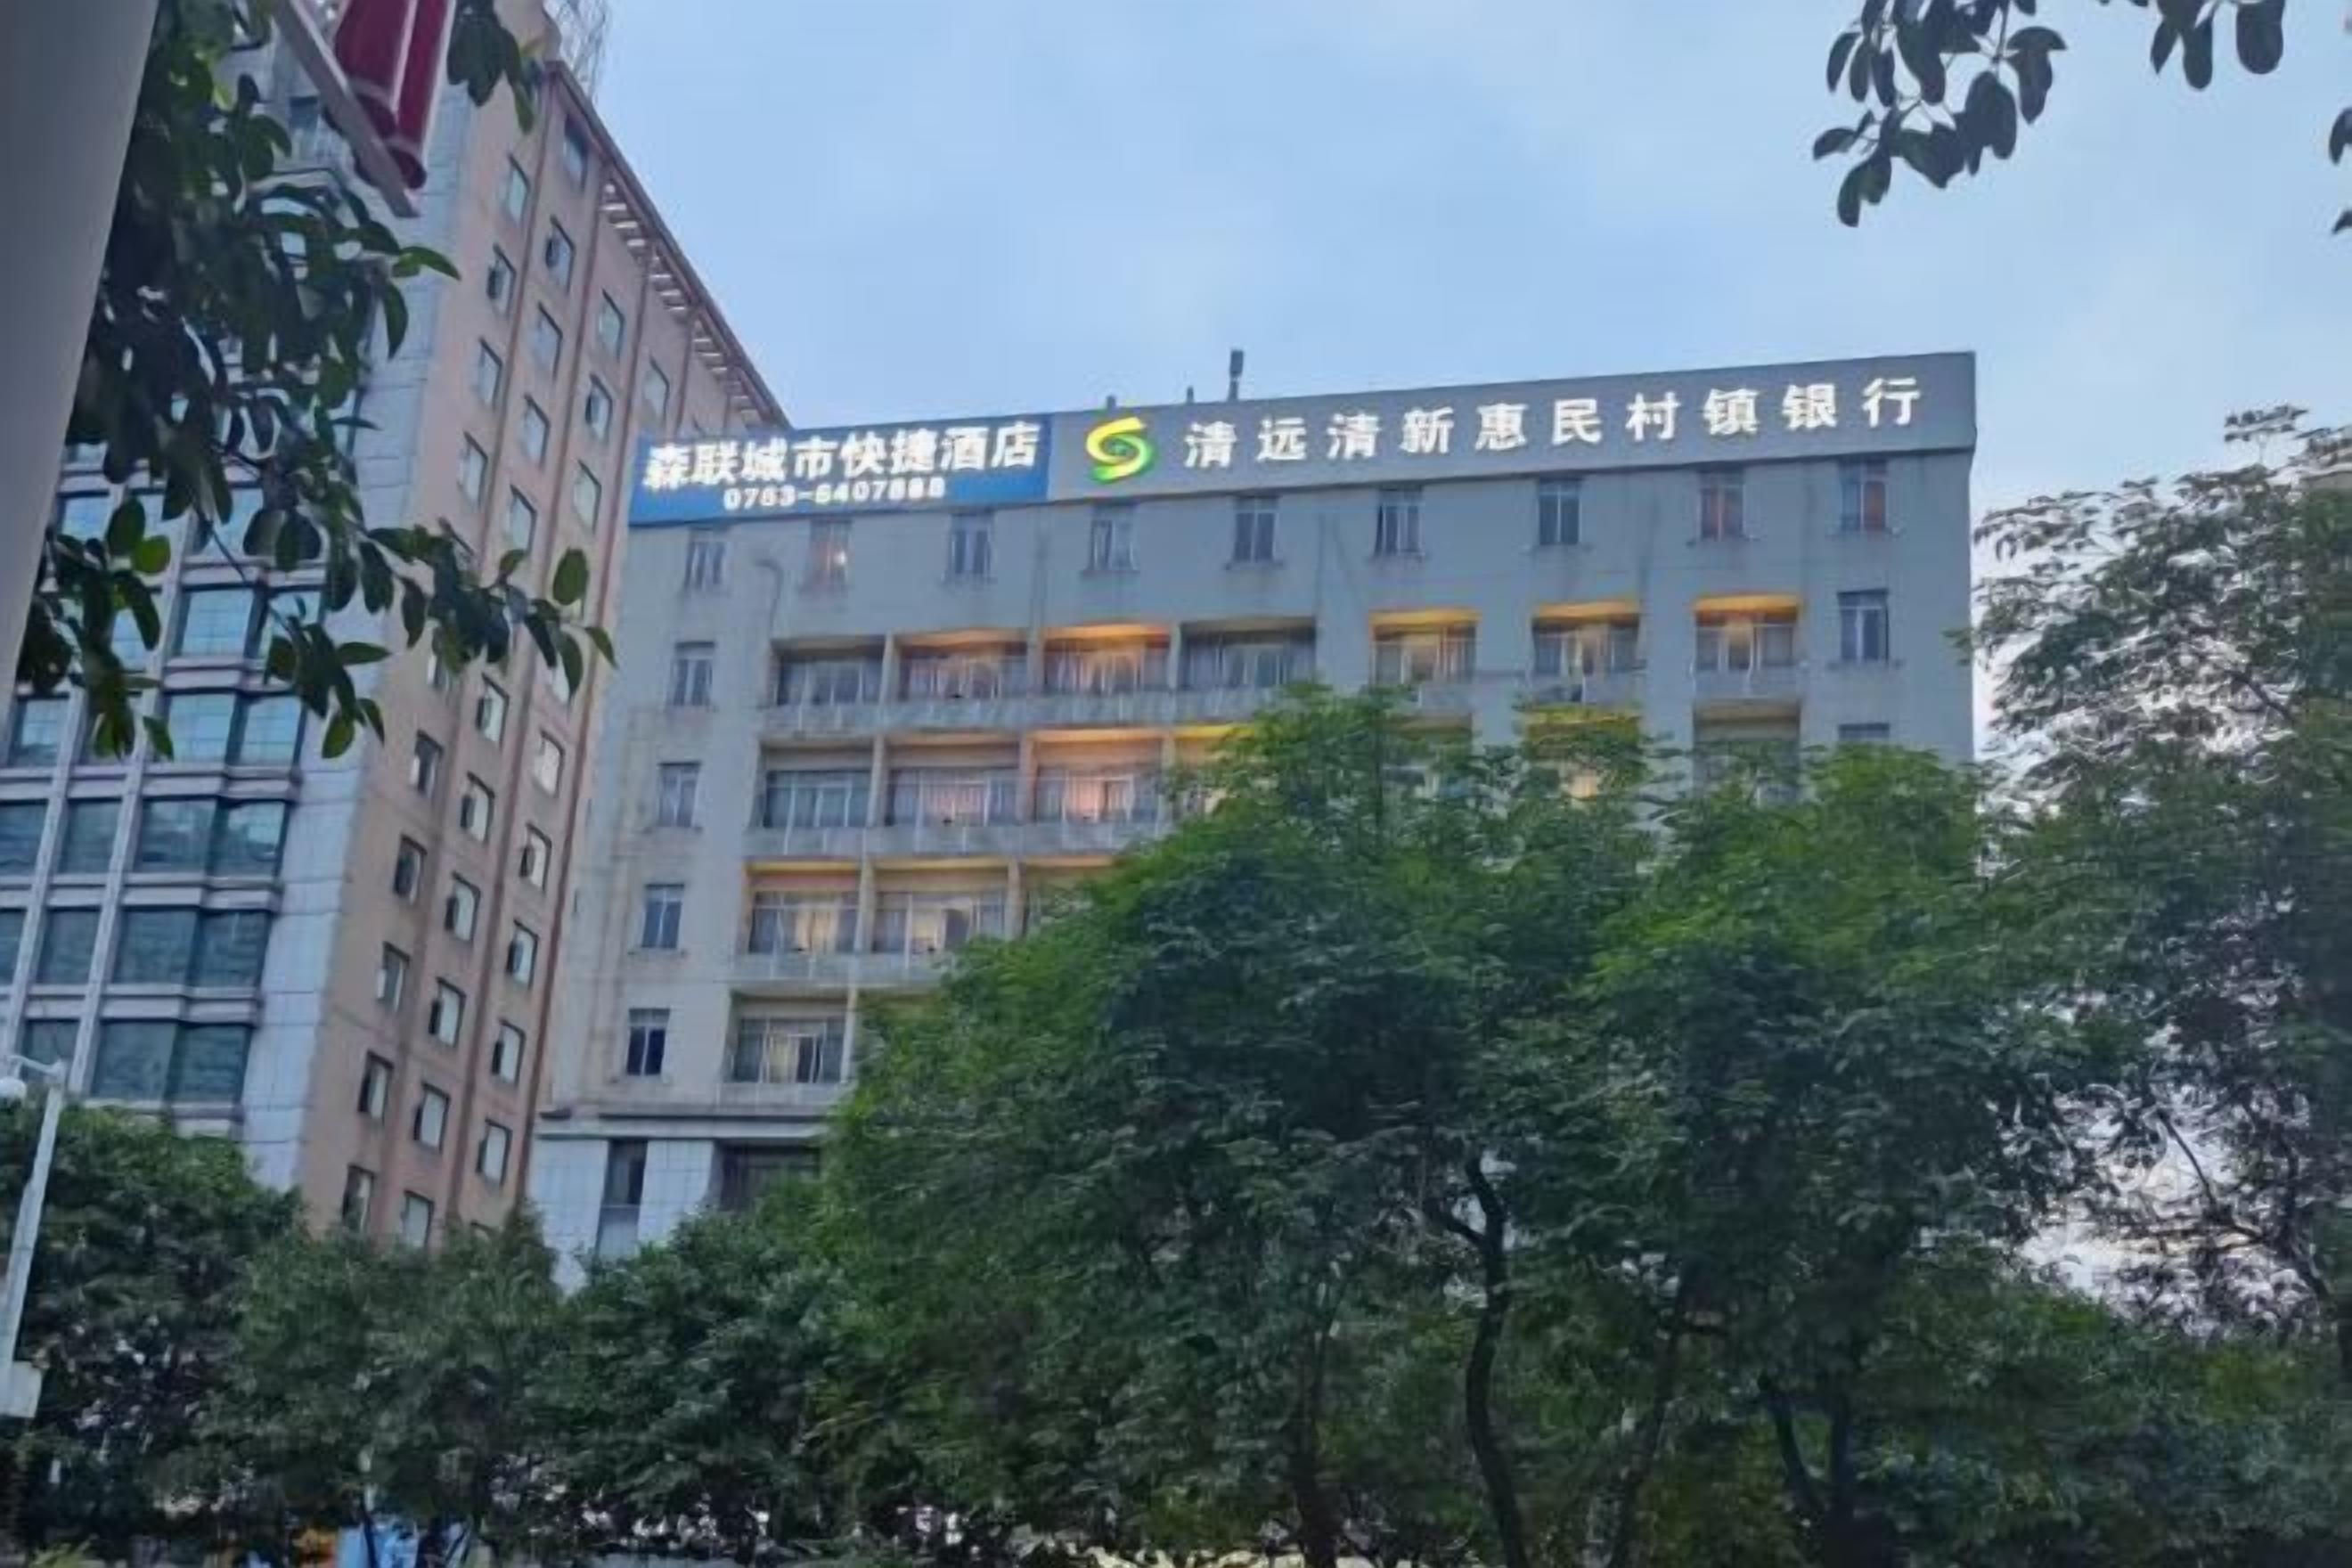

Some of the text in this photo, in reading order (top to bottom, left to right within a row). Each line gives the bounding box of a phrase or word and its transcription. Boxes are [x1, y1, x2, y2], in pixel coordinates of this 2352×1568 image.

[1184, 377, 1921, 468] 清远清新惠民村镇银行
